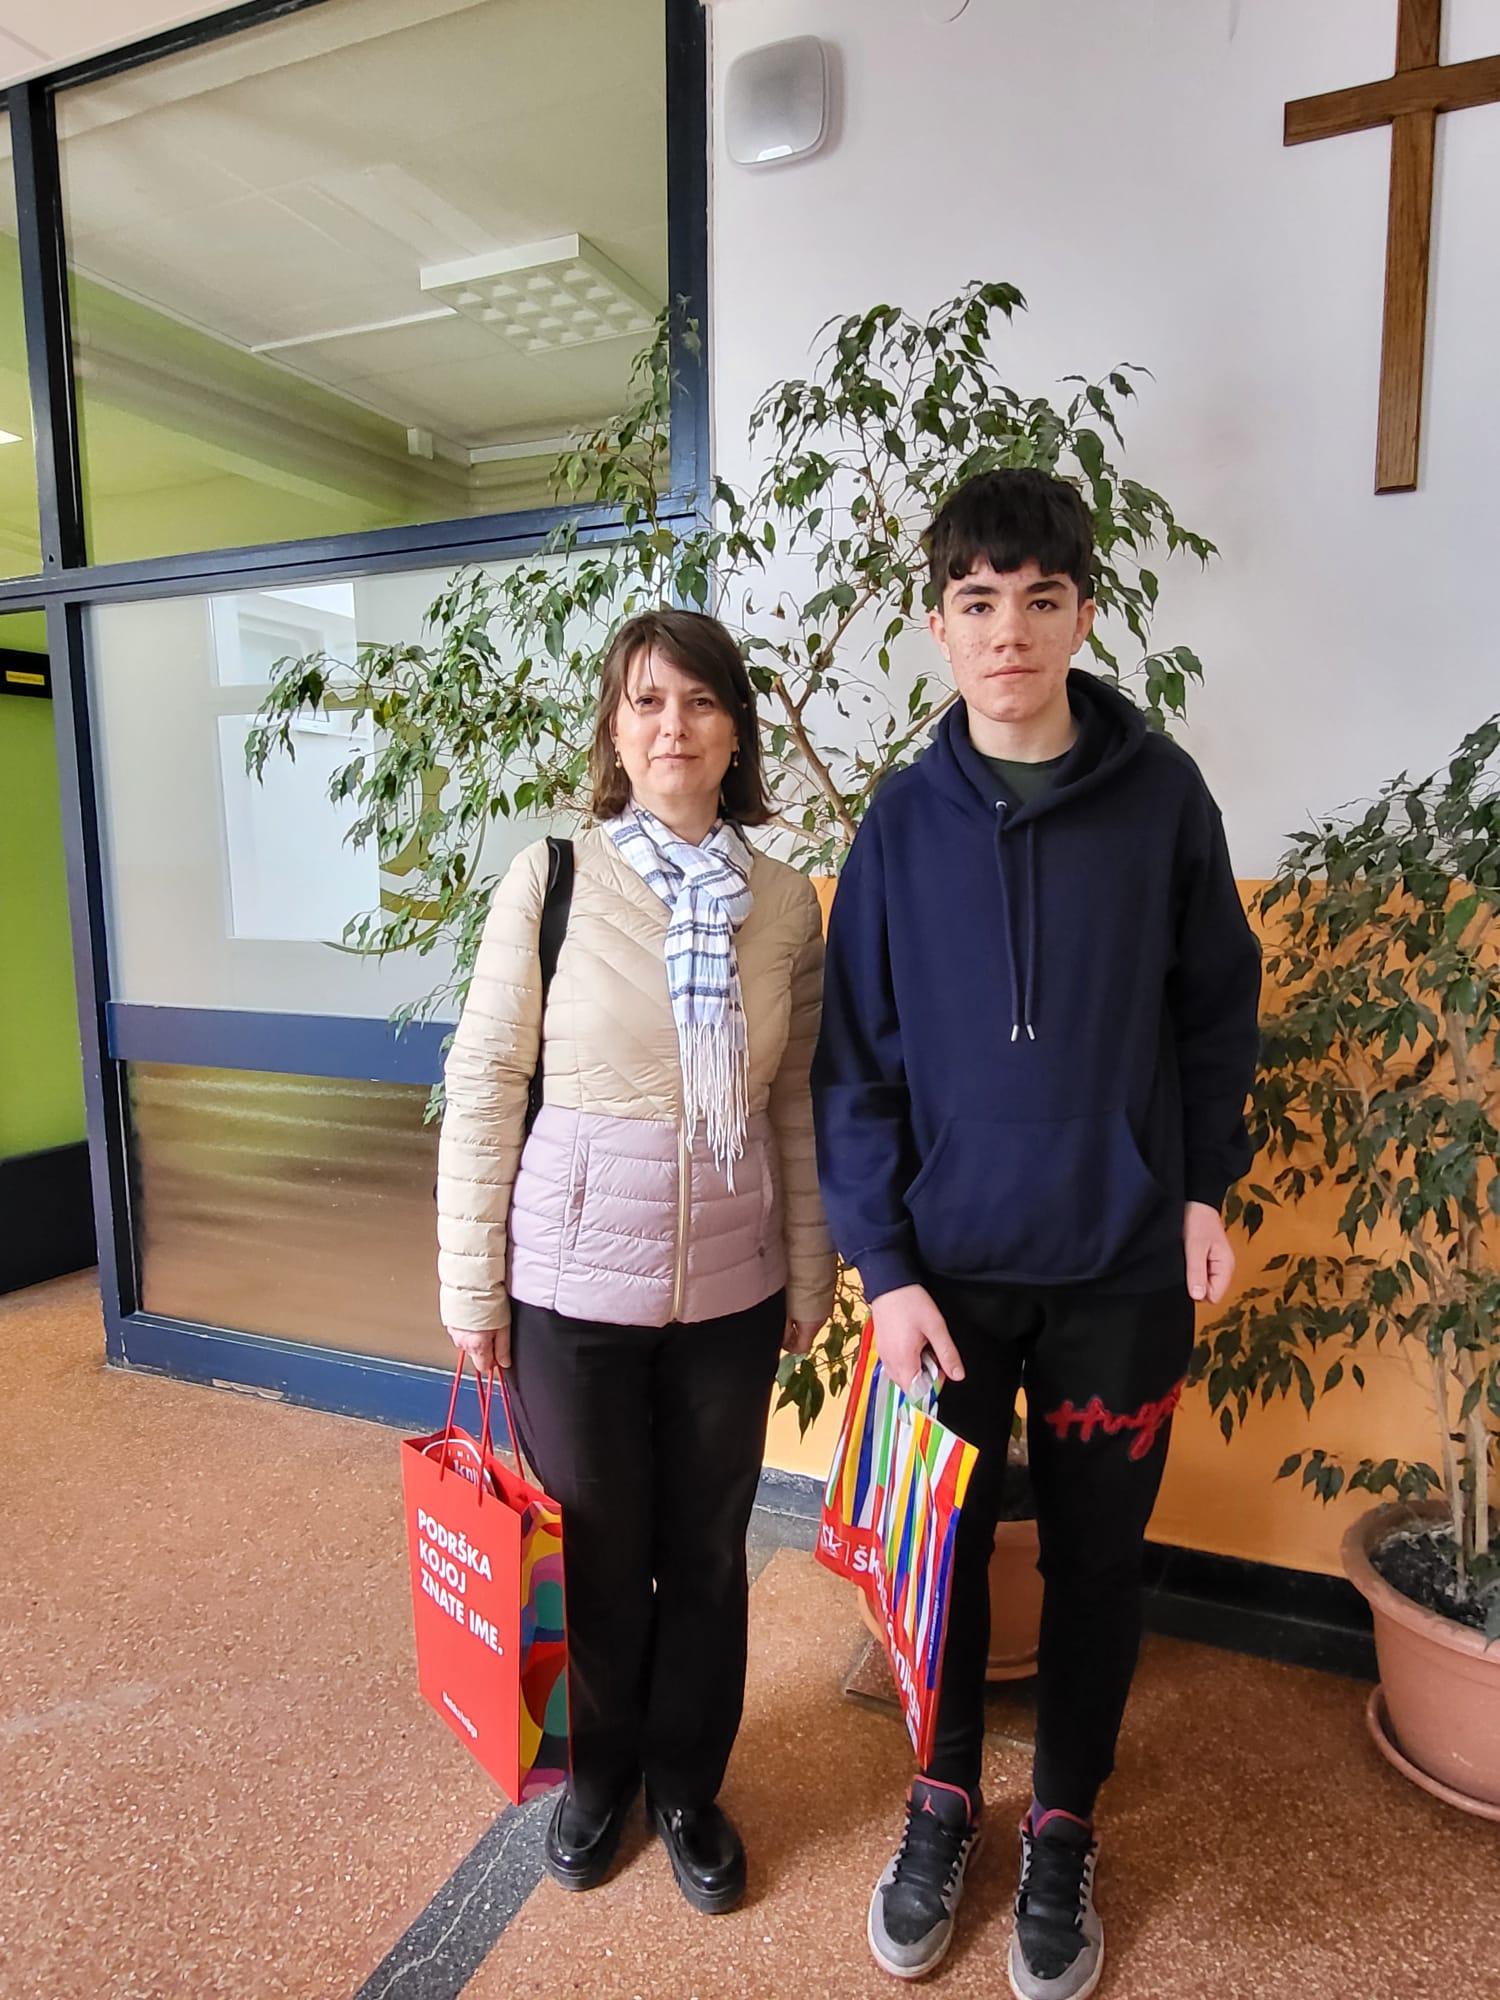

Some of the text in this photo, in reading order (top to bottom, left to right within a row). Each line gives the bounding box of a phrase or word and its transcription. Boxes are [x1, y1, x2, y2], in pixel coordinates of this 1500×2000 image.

[417, 1507, 493, 1582] PODRŠKA
[419, 1537, 466, 1594] KOJOJ
[420, 1567, 504, 1656] ZNATE IME.
